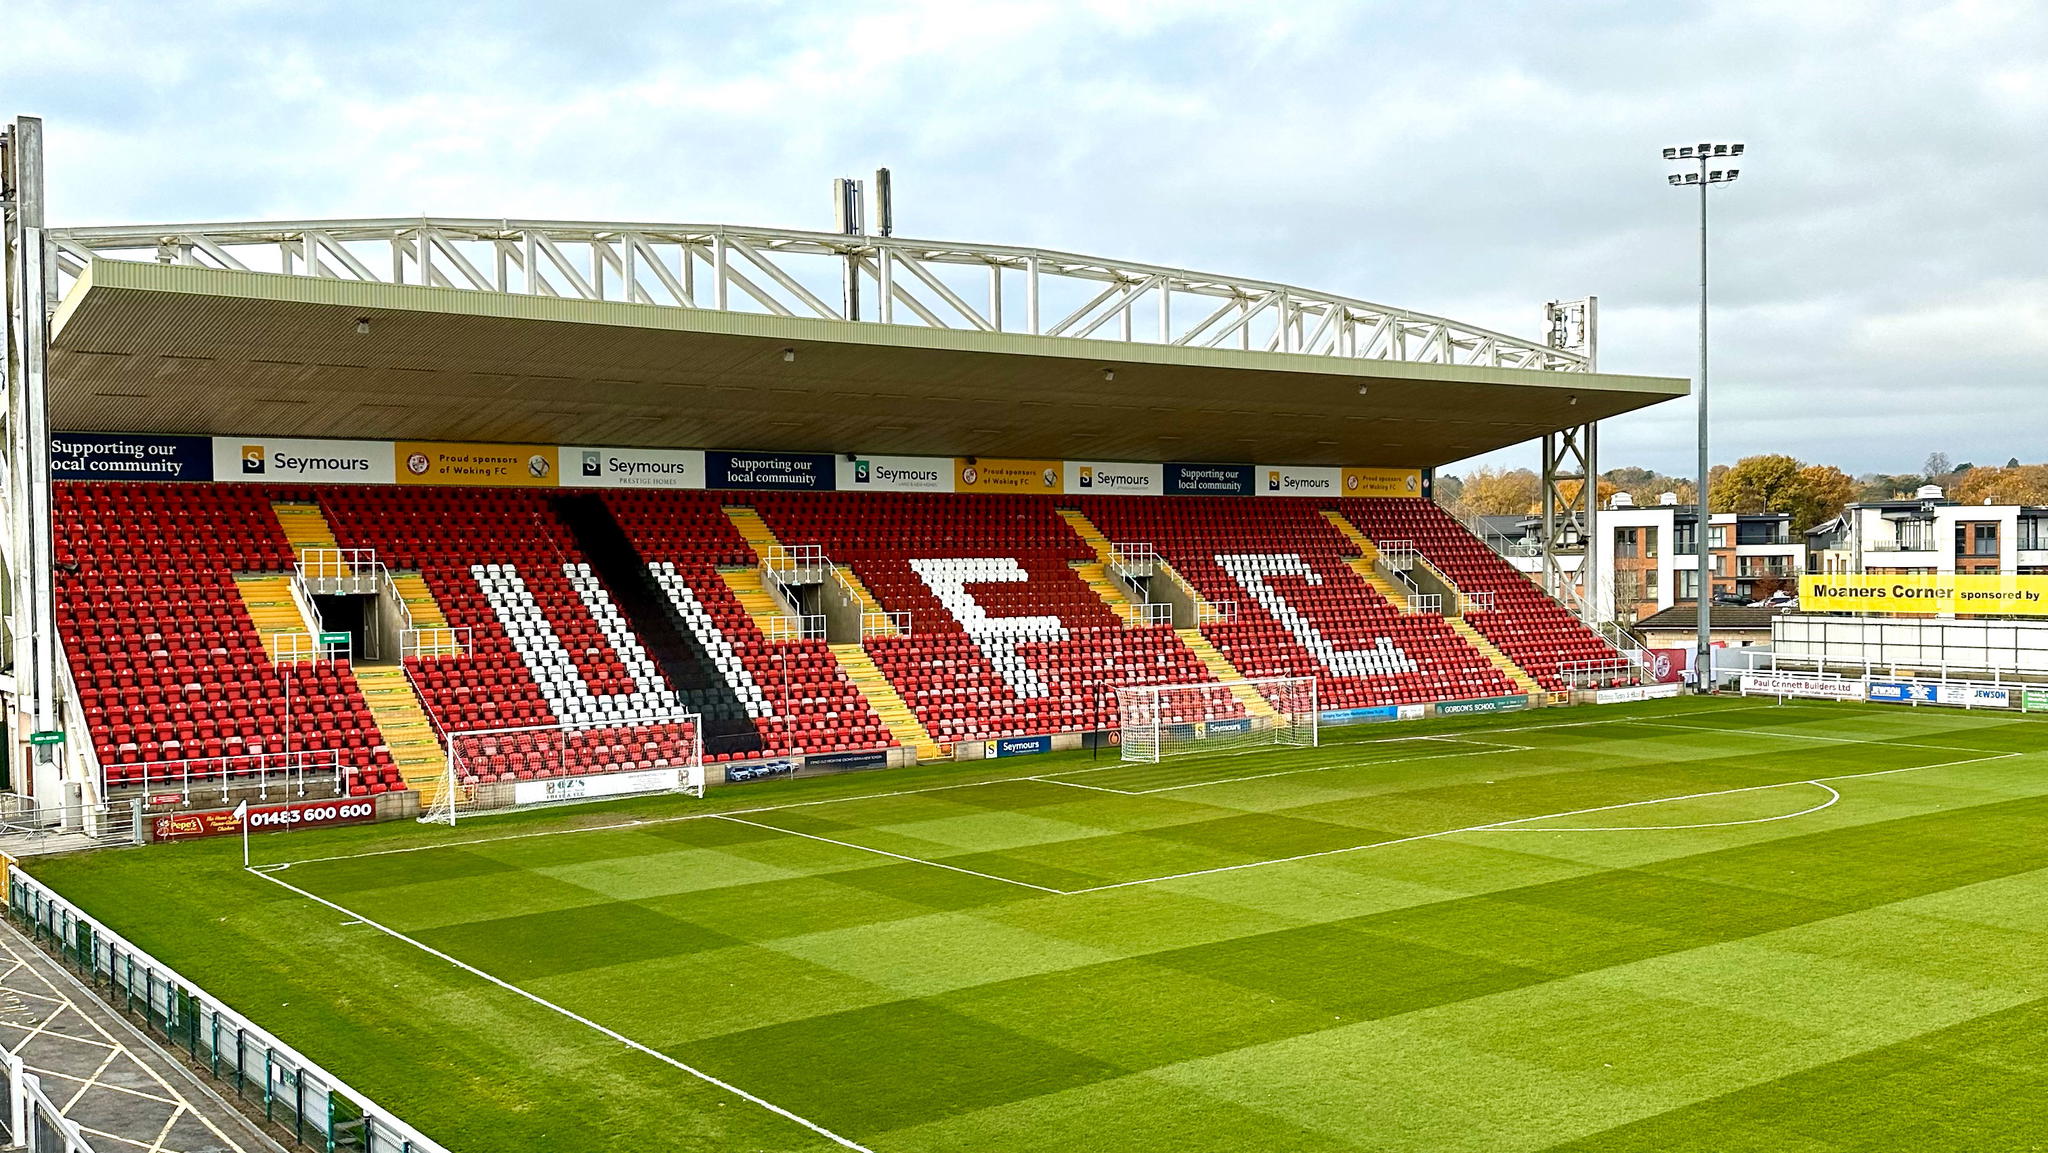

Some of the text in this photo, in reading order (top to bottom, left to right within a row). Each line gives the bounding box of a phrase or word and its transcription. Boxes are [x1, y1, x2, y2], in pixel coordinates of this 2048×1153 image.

[51, 440, 177, 459] Supporting our
[274, 452, 369, 473] Seymours
[439, 454, 518, 465] Proud sponsors
[609, 457, 685, 475] Seymours
[731, 457, 813, 473] Supporting our
[51, 458, 183, 476] ocal community
[439, 466, 508, 476] of Woking FC
[983, 467, 1004, 475] Proud
[727, 471, 817, 487] local community
[876, 466, 938, 483] Seymours
[1097, 471, 1150, 487] Seymours
[1181, 468, 1239, 481] Supporting our
[1178, 479, 1242, 492] local community
[1284, 476, 1330, 490] Seymours
[1813, 584, 2040, 602] Moaners Corner sponsored by
[1753, 679, 1770, 687] Paul
[1838, 683, 1851, 692] Ltd
[1974, 689, 2006, 699] JEWSON
[1444, 704, 1473, 714] GORDON'S
[1474, 702, 1497, 711] SCHOOL
[1209, 723, 1242, 733] Seymours
[1002, 740, 1040, 752] Seymours
[250, 803, 372, 827] 01483 600 600
